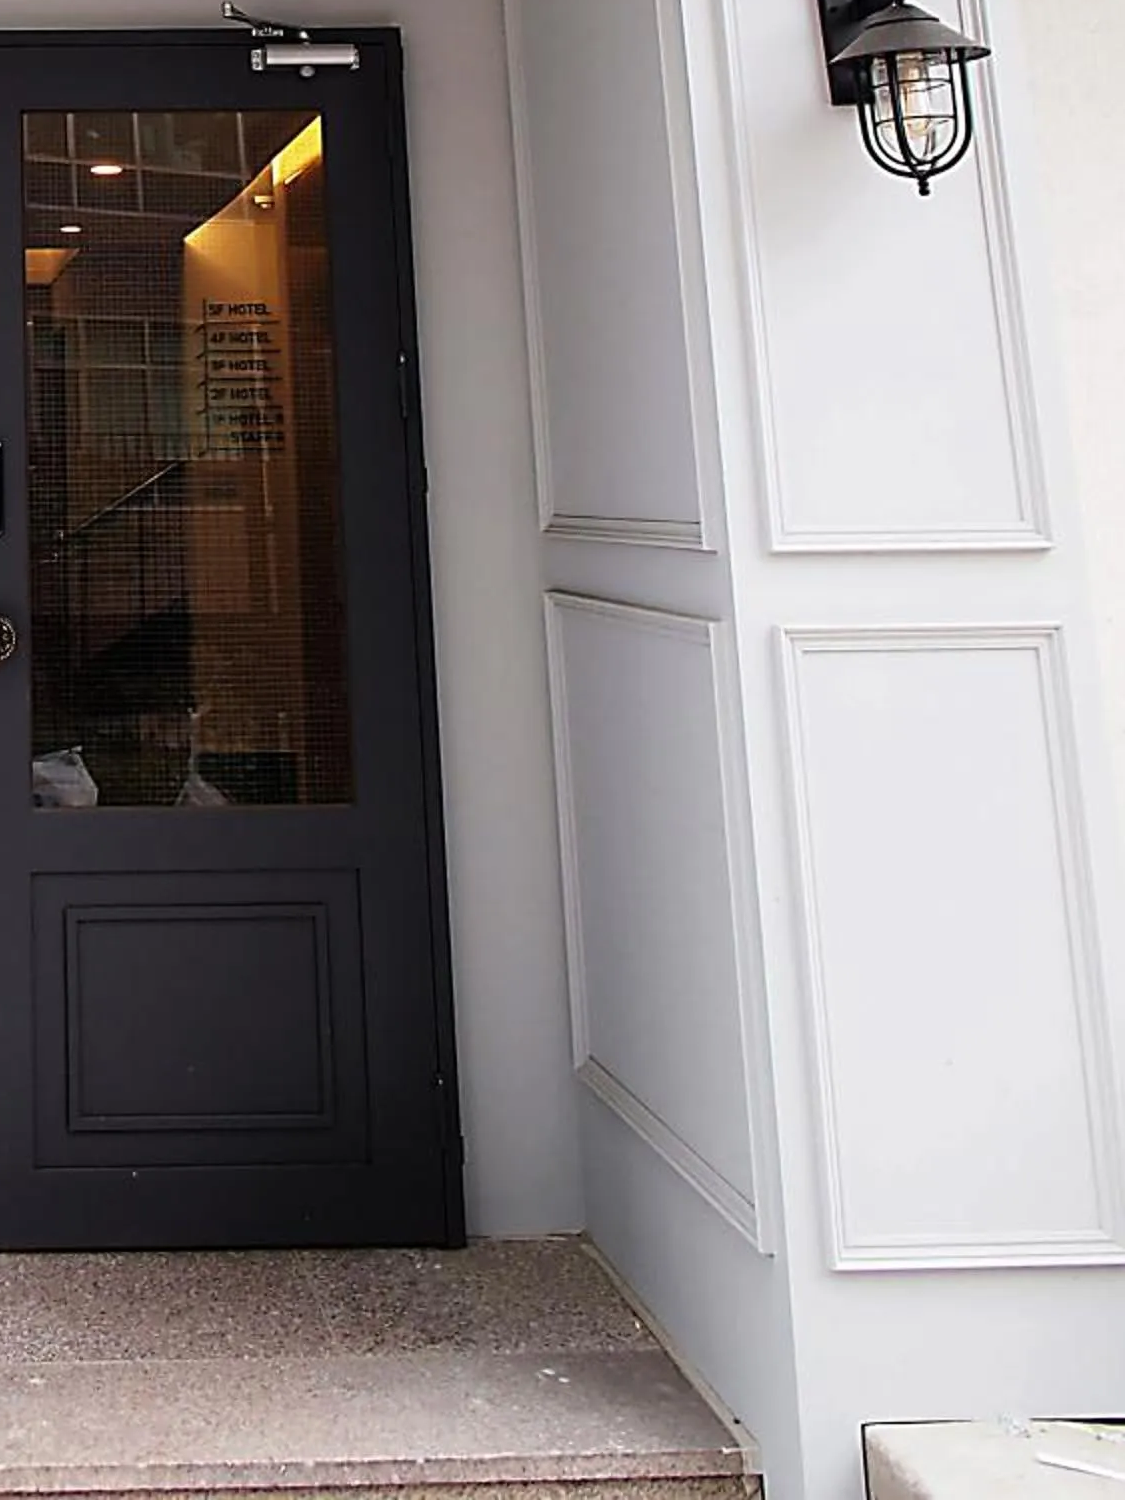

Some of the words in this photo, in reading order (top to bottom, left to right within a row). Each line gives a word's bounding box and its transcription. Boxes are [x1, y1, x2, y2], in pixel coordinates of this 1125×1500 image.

[228, 303, 271, 315] HOTEL
[229, 332, 272, 343] HOTEL
[229, 359, 272, 371] HOTEL
[230, 388, 272, 400] HOTEL
